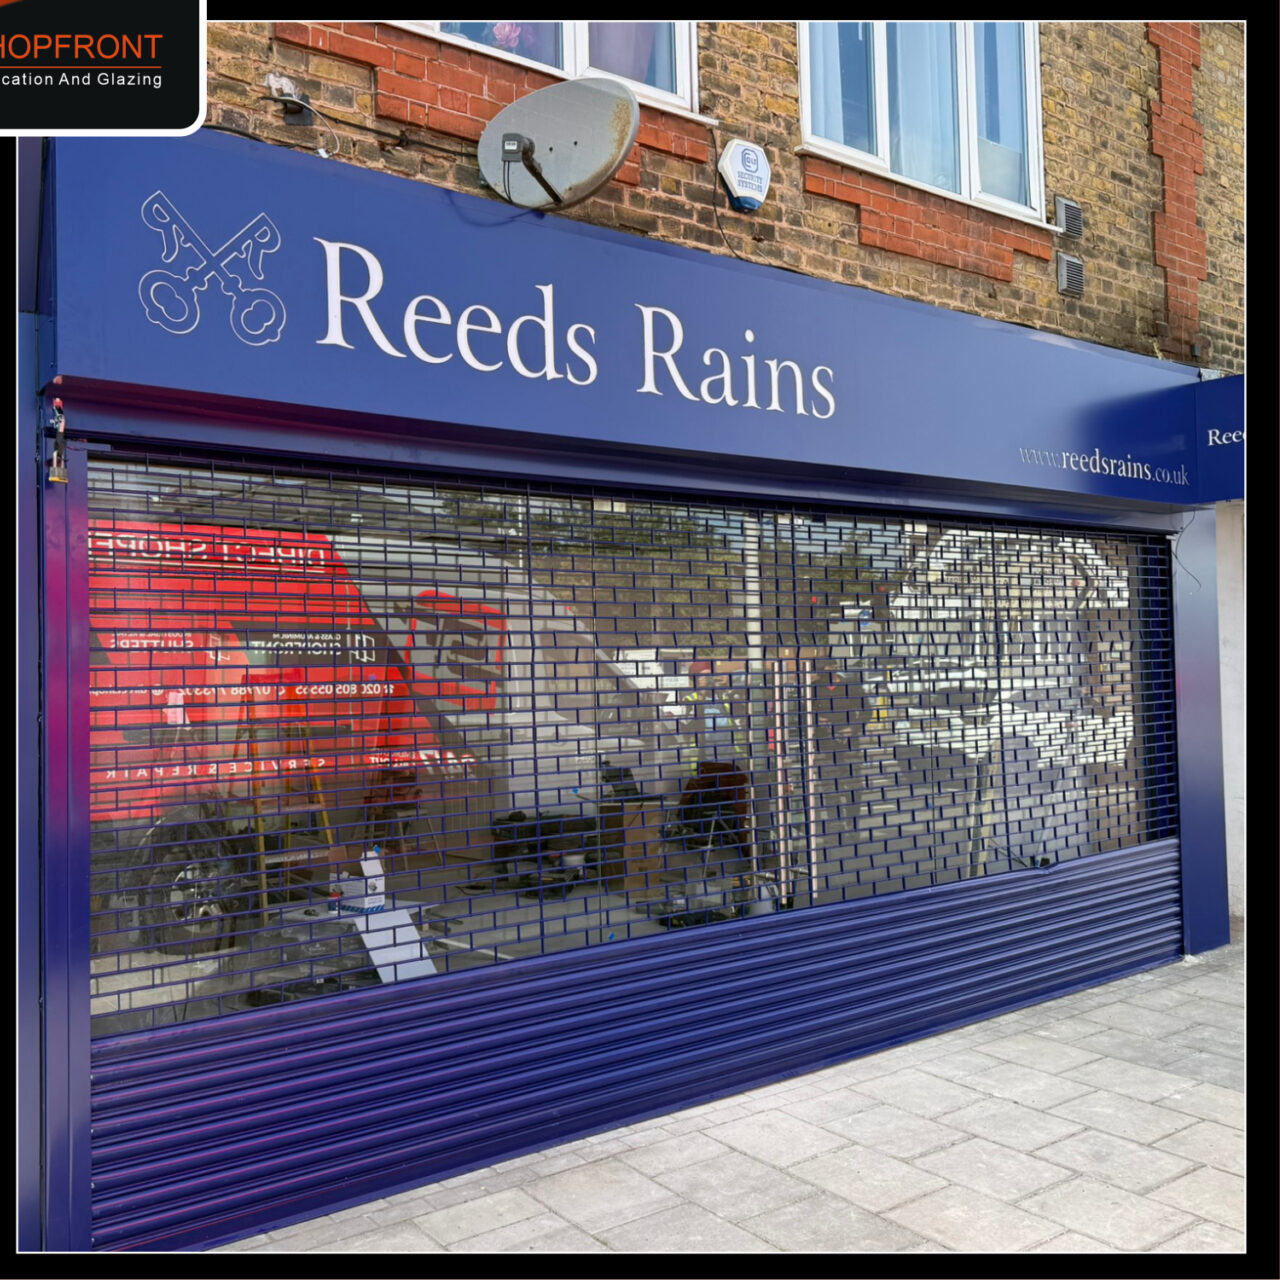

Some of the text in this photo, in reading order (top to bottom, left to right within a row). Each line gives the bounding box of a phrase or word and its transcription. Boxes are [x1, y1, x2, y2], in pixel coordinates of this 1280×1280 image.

[313, 236, 837, 420] Reeds Rains
[1019, 448, 1190, 487] www.reedsrains.co.uk
